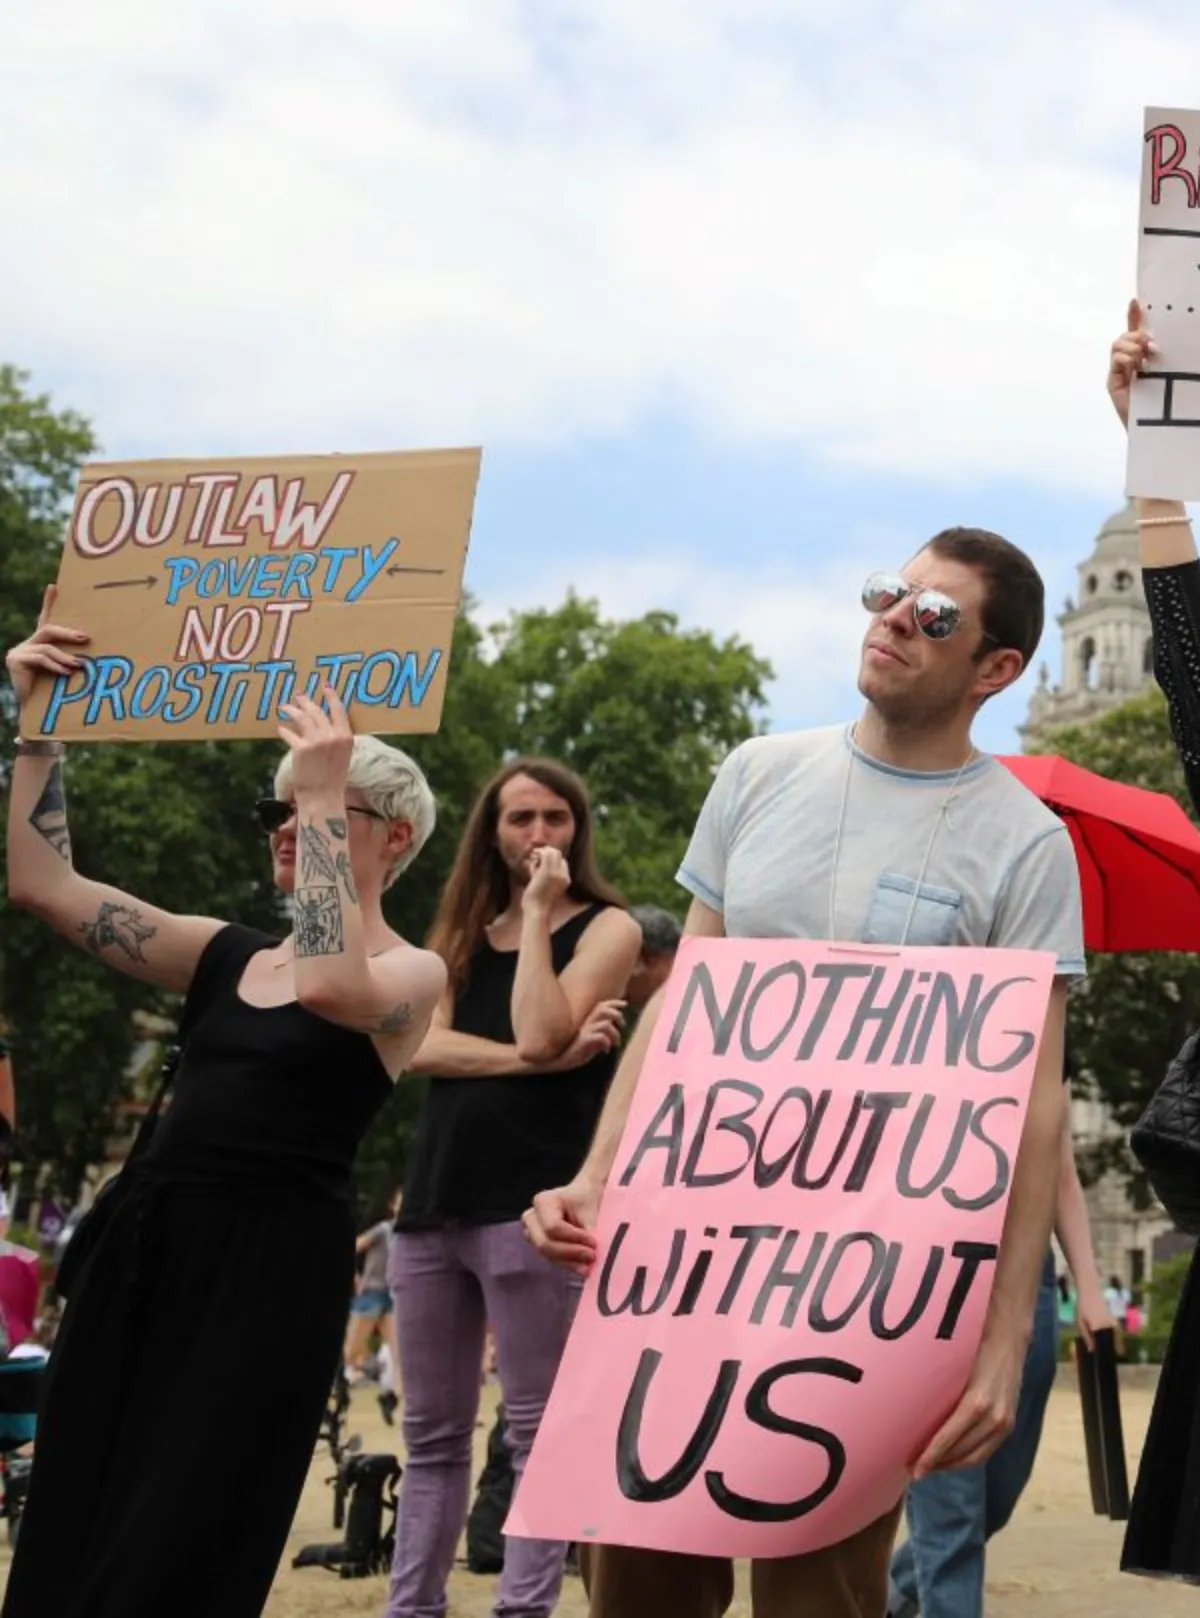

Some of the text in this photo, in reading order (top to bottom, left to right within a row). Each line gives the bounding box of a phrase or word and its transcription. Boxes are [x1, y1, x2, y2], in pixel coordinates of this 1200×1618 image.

[73, 471, 356, 558] OUTLAW
[164, 537, 400, 605] POVERTY
[175, 601, 312, 663] NOT
[619, 1078, 1020, 1211] ABOUT US
[615, 1347, 864, 1523] US
